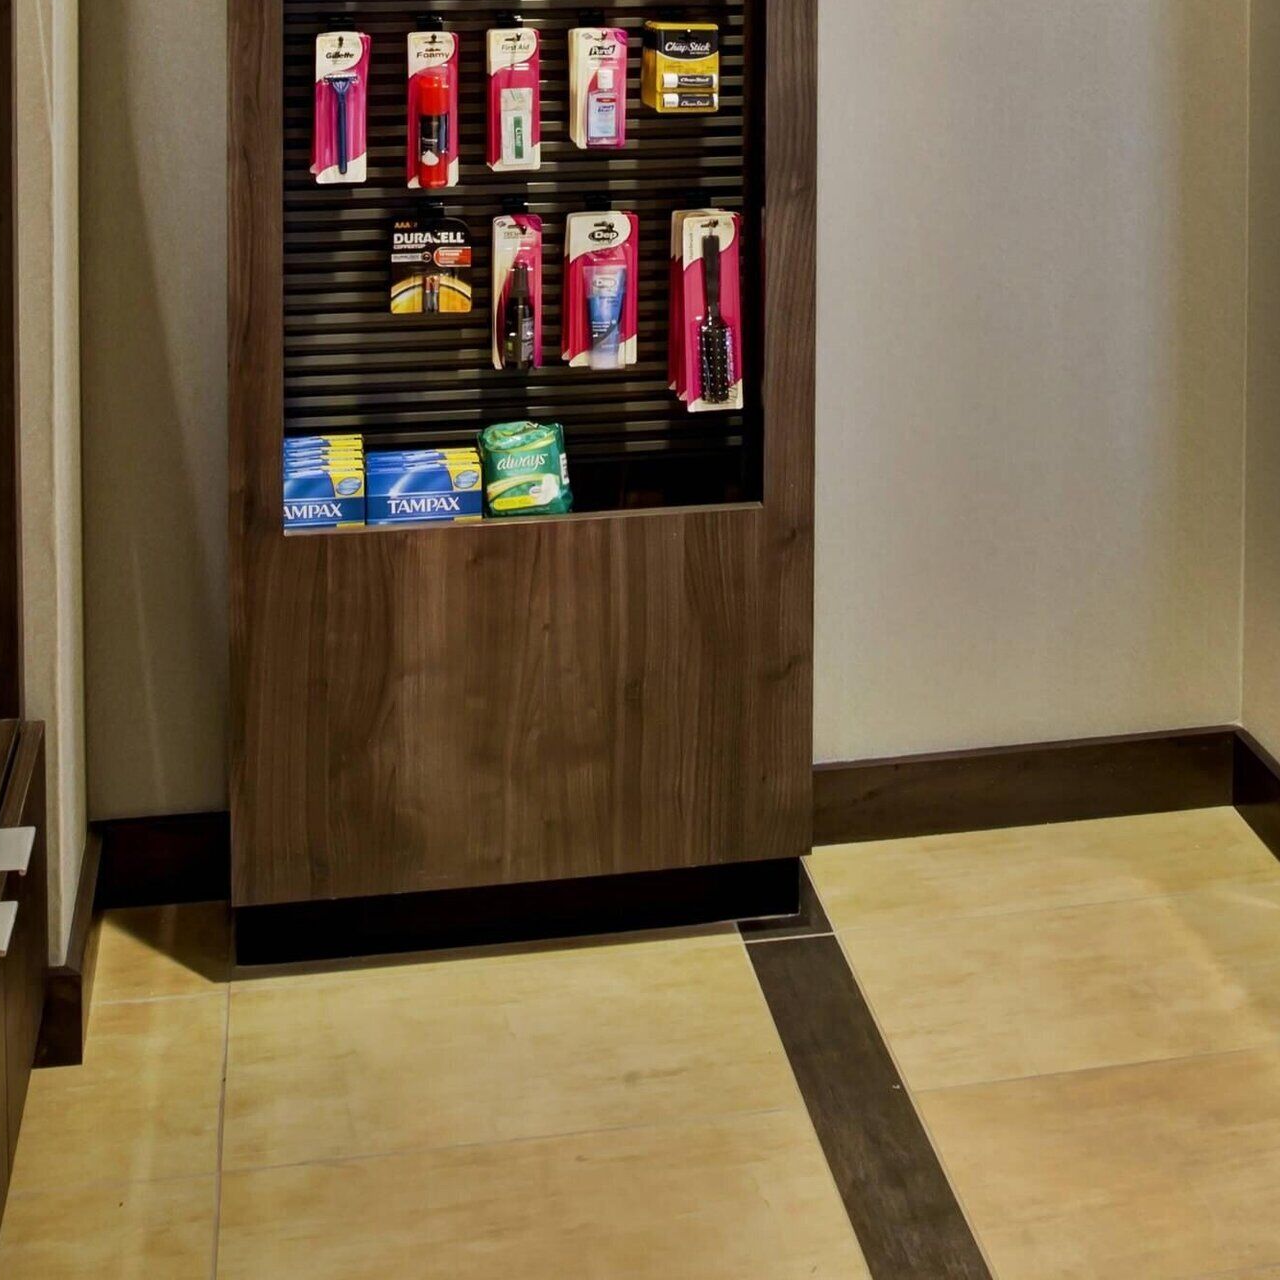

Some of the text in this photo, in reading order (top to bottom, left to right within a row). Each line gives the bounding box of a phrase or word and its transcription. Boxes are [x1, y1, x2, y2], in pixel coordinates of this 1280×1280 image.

[416, 51, 450, 60] Foamy
[393, 231, 465, 245] DURACELL
[593, 230, 617, 241] Dep
[497, 452, 548, 471] always
[284, 503, 343, 519] AMPAX
[387, 496, 460, 514] TAMPAX
